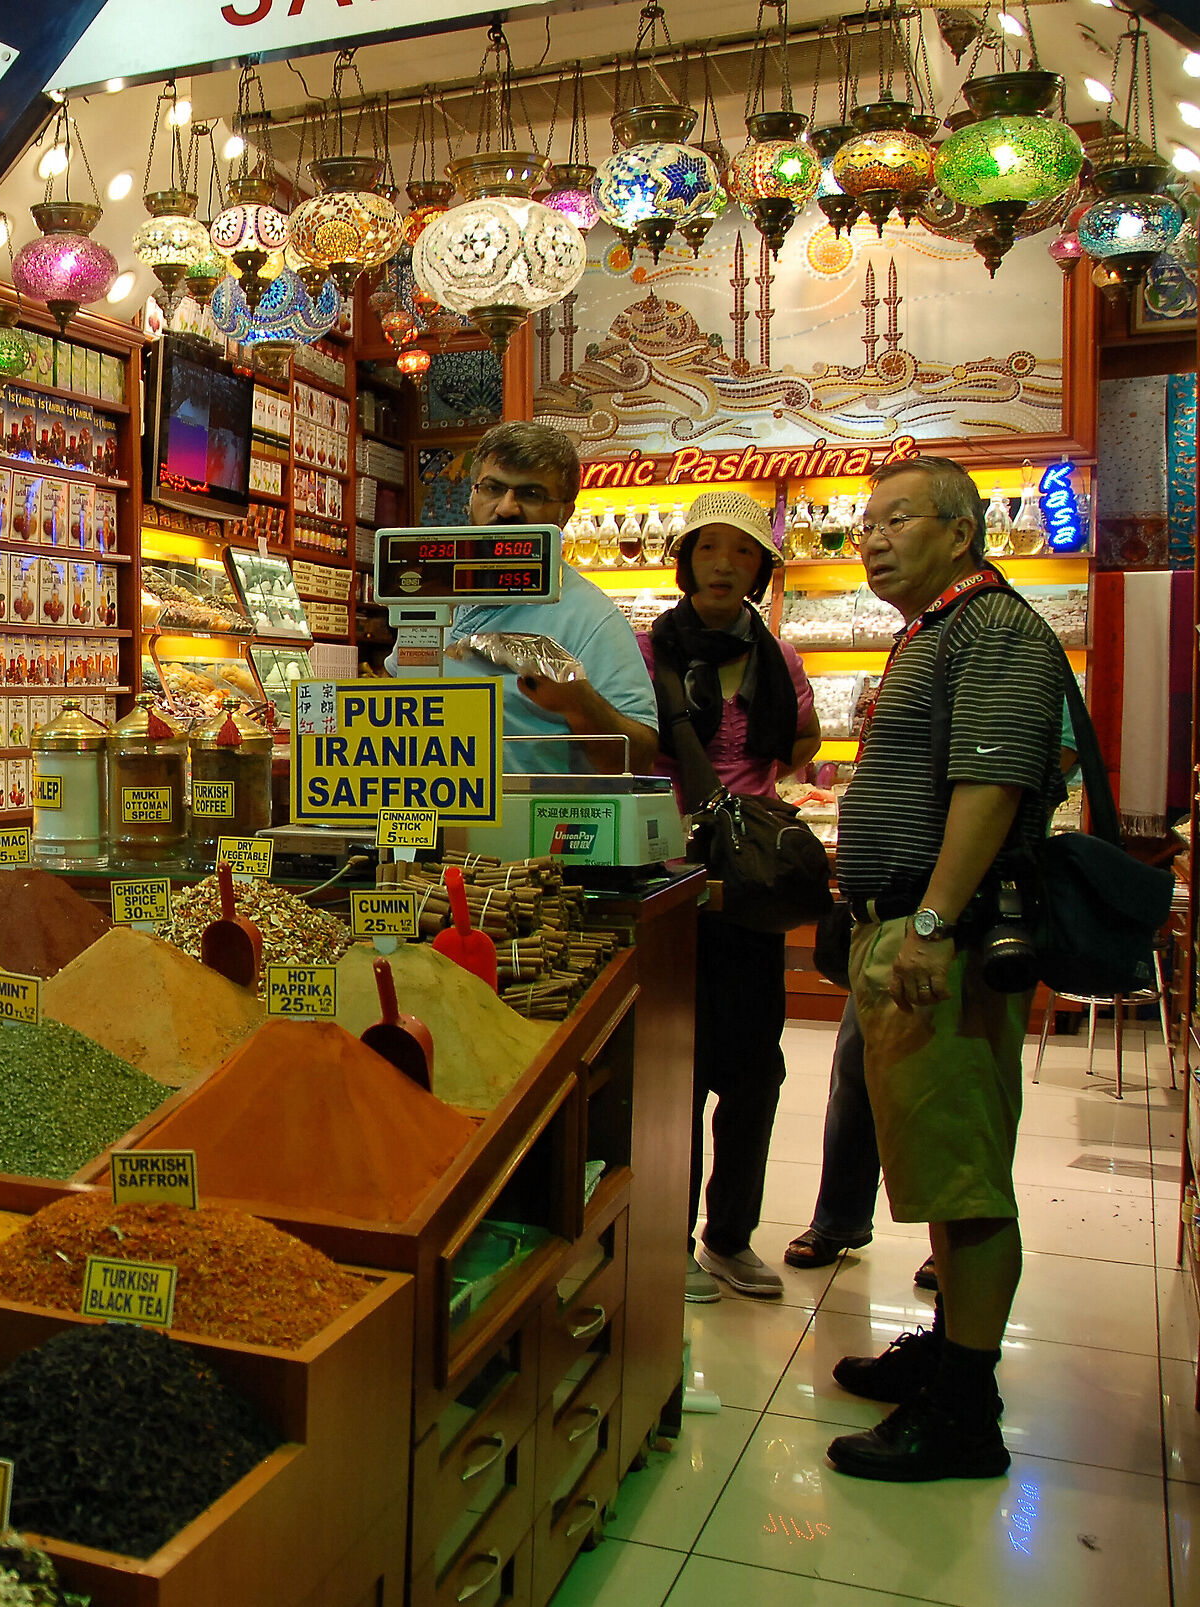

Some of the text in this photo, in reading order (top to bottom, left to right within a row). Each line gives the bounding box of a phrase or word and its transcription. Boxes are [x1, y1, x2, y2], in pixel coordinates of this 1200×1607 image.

[581, 450, 654, 487] mic
[669, 438, 874, 483] Pashmina
[344, 696, 445, 728] PURE
[315, 735, 476, 767] IRANIAN
[132, 791, 159, 800] MUKI
[195, 785, 229, 799] TURKISH
[308, 776, 484, 809] SAFFRON
[125, 801, 168, 811] OTTOMAN
[196, 800, 226, 813] COFFEE
[131, 811, 162, 820] SPICE
[382, 812, 433, 822] CINNAMON
[536, 807, 613, 819] 欢迎使用银联卡
[391, 822, 421, 831] STICK
[554, 831, 595, 843] UnionPay
[237, 841, 253, 851] DRY
[221, 850, 268, 862] VEGETABLE
[115, 884, 165, 896] CHICKEN
[124, 895, 157, 907] SPICE
[358, 899, 410, 914] CUMIN
[287, 970, 316, 983] HOT
[271, 984, 333, 997] PAPRIKA
[118, 1158, 187, 1172] TURKISH
[118, 1173, 190, 1188] SAFFRON
[102, 1268, 159, 1293] TURKISH
[90, 1290, 164, 1318] BLACK TEA
